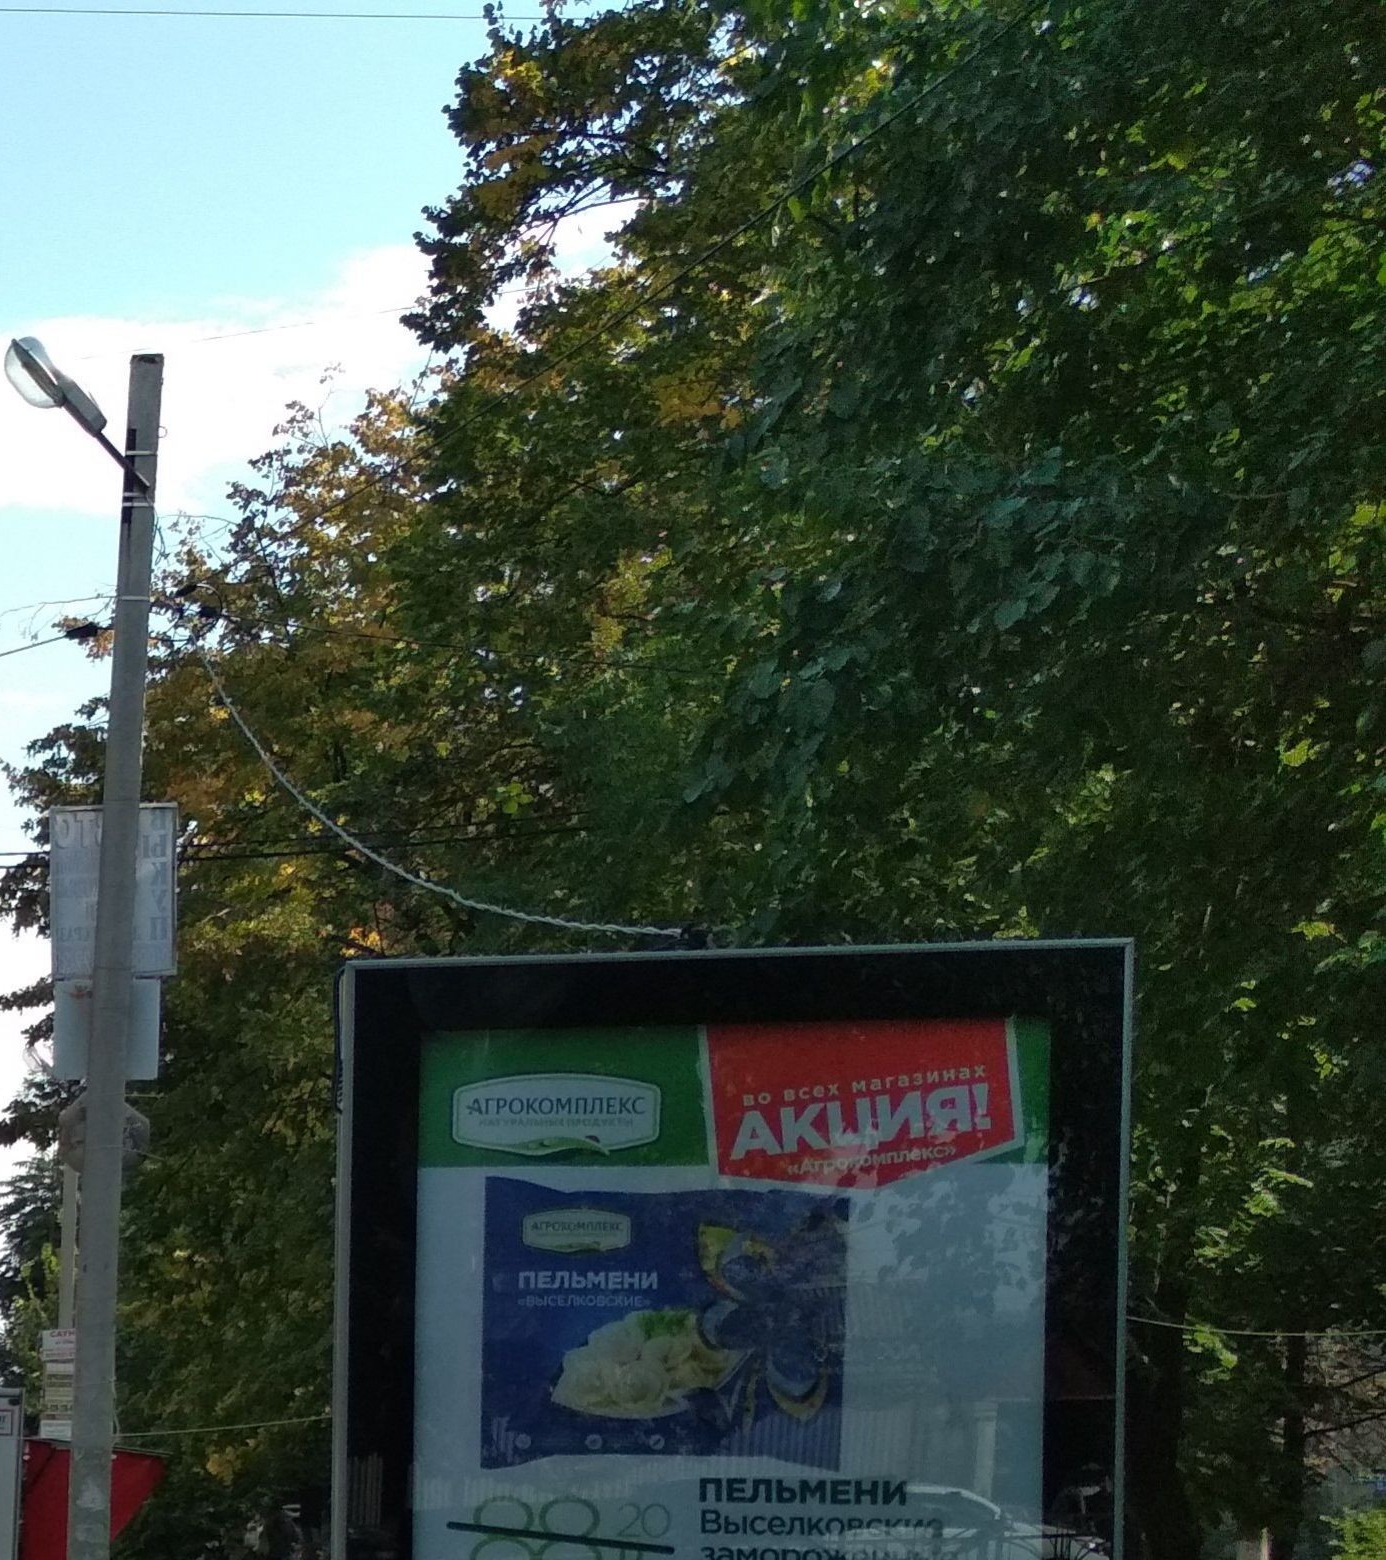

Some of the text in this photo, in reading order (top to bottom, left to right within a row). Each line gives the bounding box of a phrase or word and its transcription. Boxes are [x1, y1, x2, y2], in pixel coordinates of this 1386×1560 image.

[743, 1064, 987, 1107] во всех магазинах
[466, 1096, 646, 1116] АГРОКОМПЛЕКС
[730, 1082, 992, 1161] АКЦИЯ!
[531, 1221, 624, 1232] АГРОКОМПЛЕКС
[518, 1270, 658, 1290] ПЕЛЬМЕНИ
[699, 1477, 908, 1506] ПЕЛЬМЕНИ
[617, 1503, 672, 1539] 20
